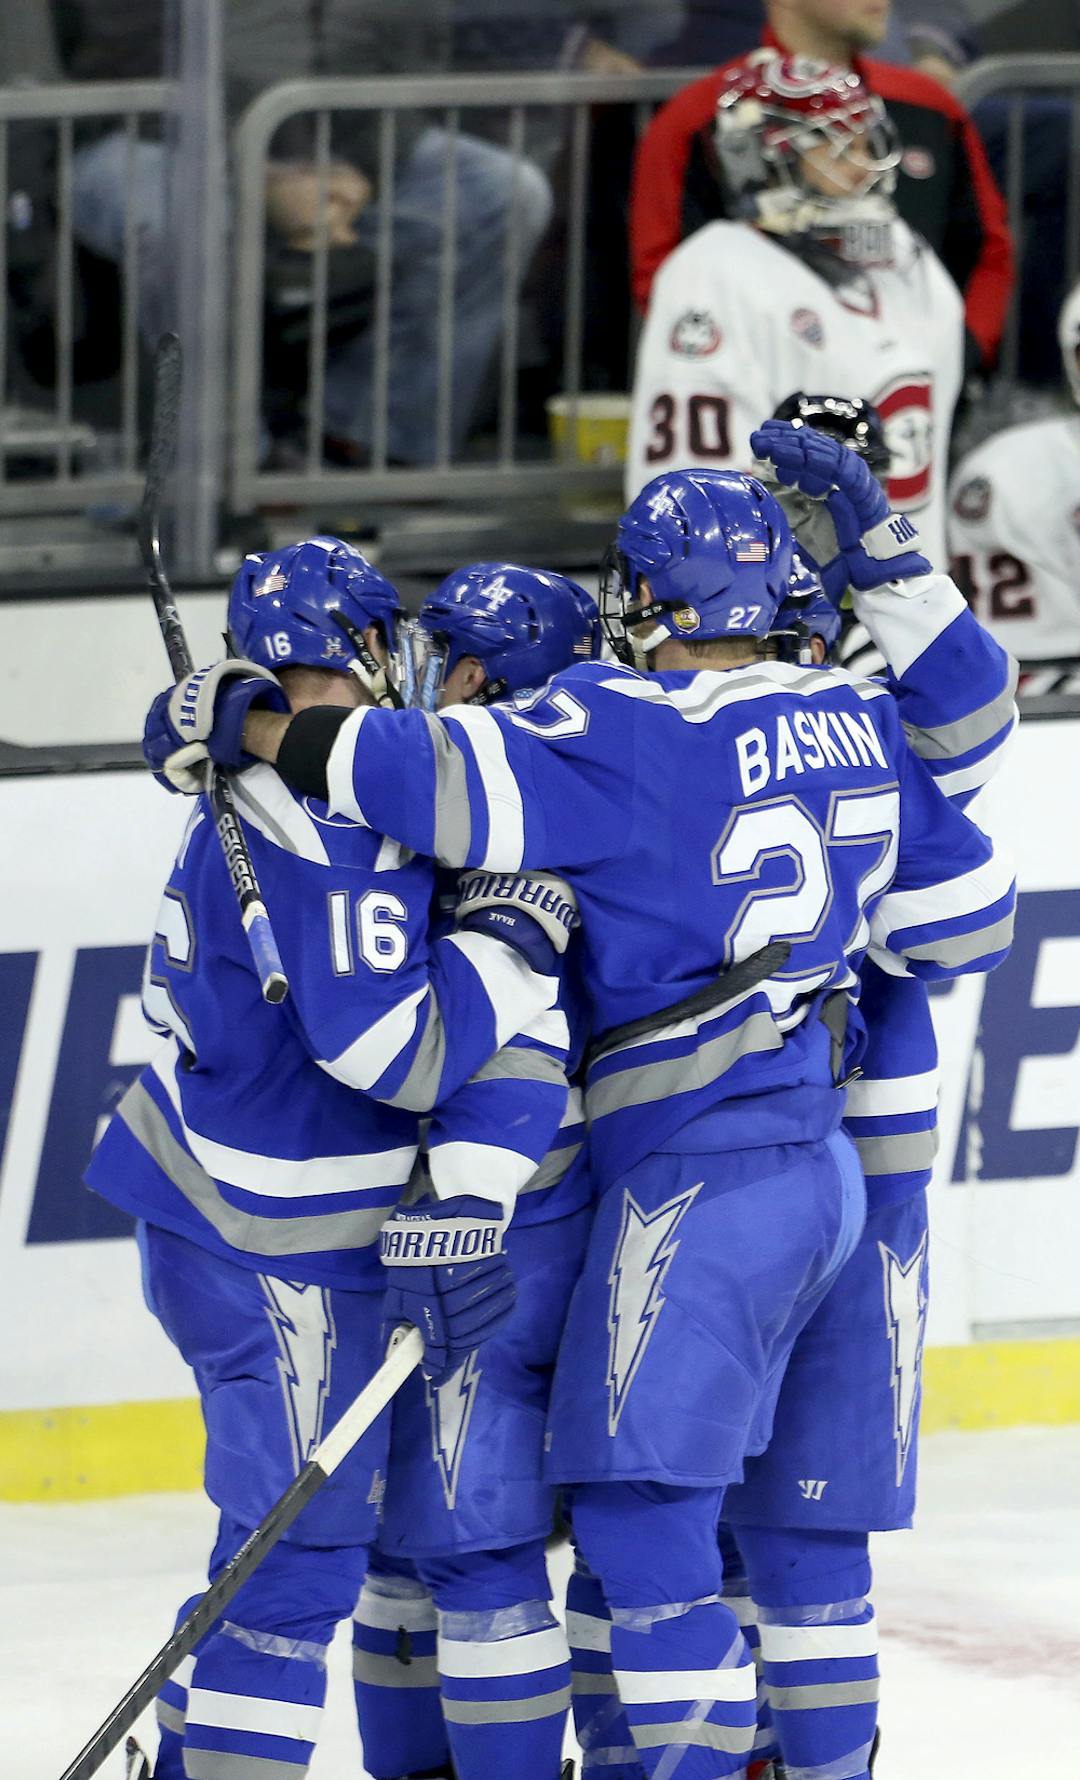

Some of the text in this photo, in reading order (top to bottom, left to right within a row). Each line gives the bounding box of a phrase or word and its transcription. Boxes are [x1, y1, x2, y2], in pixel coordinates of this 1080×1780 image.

[645, 393, 730, 463] 30
[264, 631, 293, 660] 16
[726, 604, 762, 630] 27
[734, 710, 889, 799] BASKIN
[711, 780, 901, 992] 27
[328, 889, 409, 977] 16
